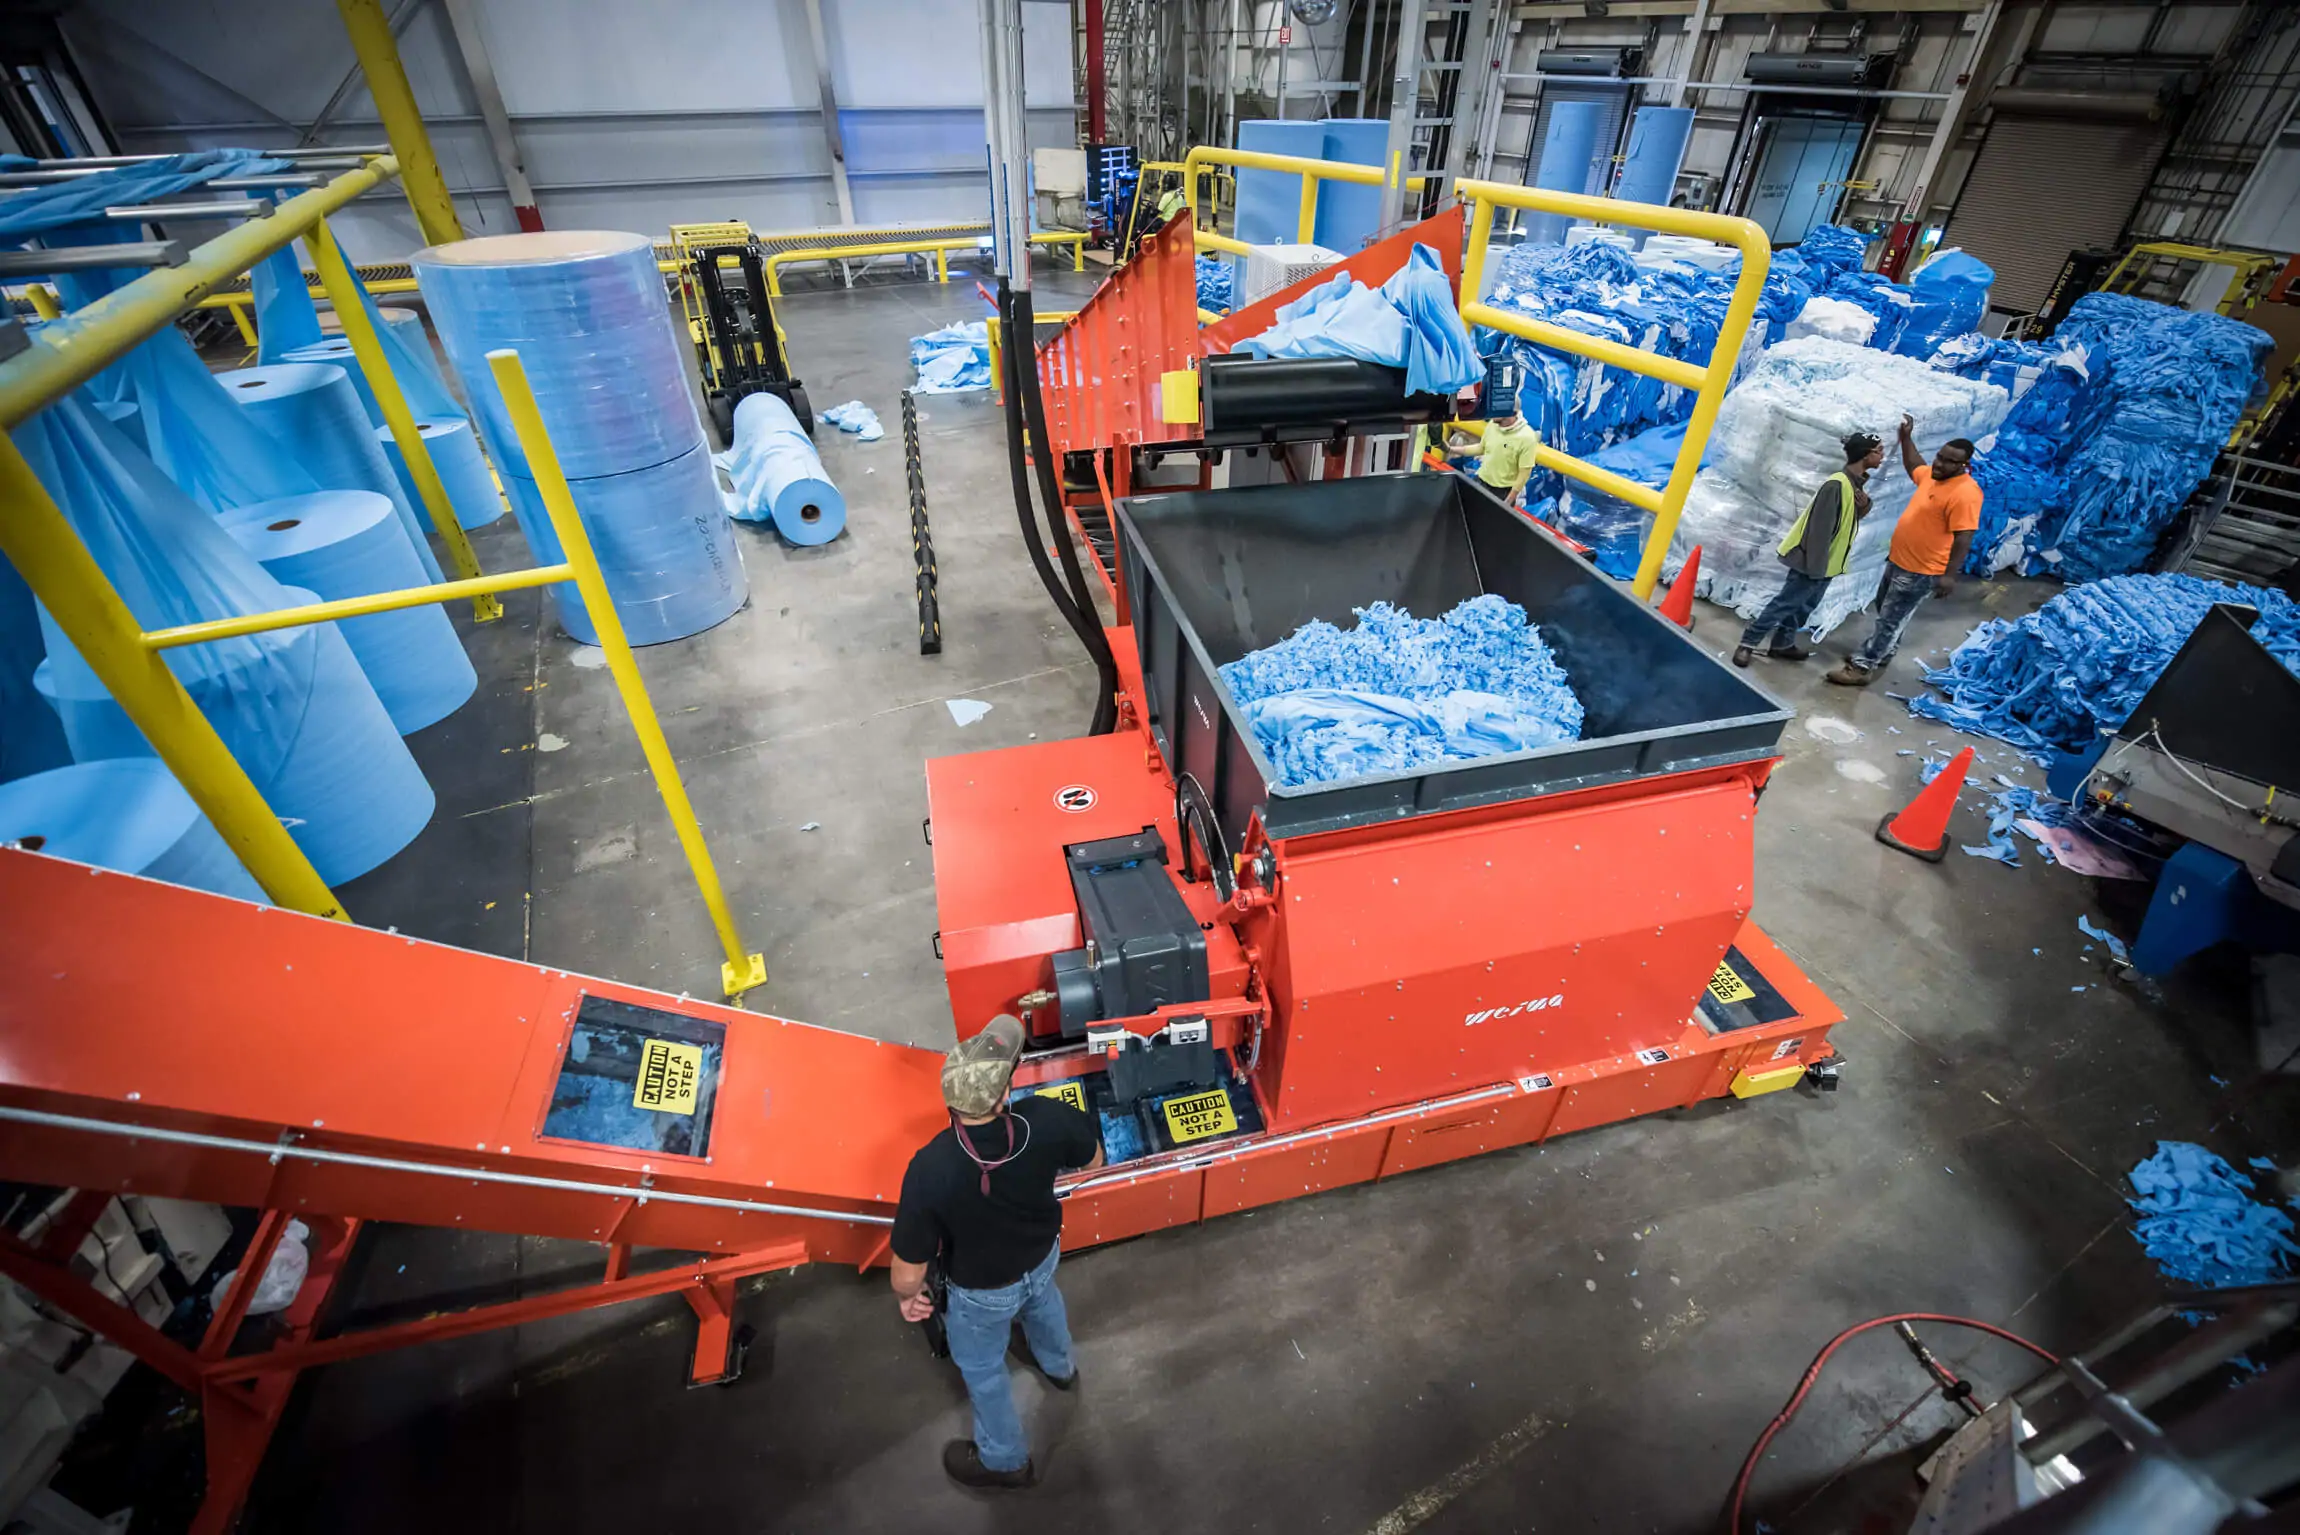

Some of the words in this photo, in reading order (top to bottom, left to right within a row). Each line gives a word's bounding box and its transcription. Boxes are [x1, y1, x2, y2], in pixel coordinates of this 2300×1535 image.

[2050, 261, 2076, 299] HYSTER
[671, 1056, 682, 1065] A
[643, 1045, 668, 1104] CAUTION
[665, 1068, 679, 1099] NOT
[680, 1061, 694, 1098] STEP
[1170, 1095, 1224, 1116] CAUTION
[1179, 1113, 1208, 1126] NOT
[1214, 1110, 1223, 1119] A
[1185, 1121, 1222, 1135] STEP
